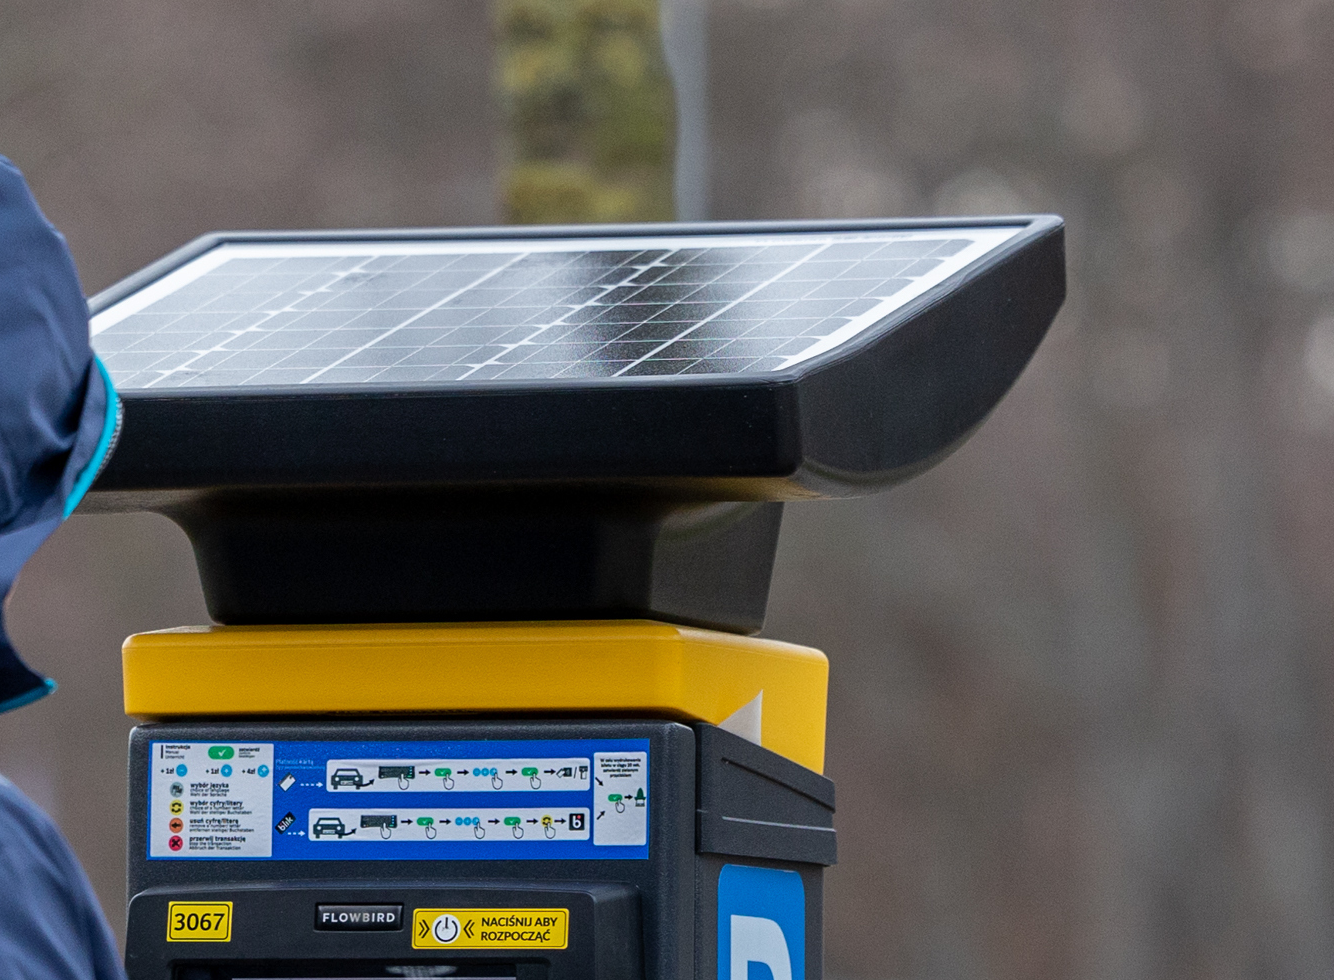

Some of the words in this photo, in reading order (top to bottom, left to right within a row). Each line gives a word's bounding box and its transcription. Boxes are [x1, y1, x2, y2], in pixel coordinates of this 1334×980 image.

[210, 782, 229, 790] języka
[277, 816, 293, 831] blik
[174, 913, 225, 931] 3067
[323, 912, 395, 923] FLOWBIRD
[481, 914, 533, 927] NACIŚNIJ
[535, 917, 558, 927] ABY
[481, 930, 551, 943] ROZPOCZĄĆ
